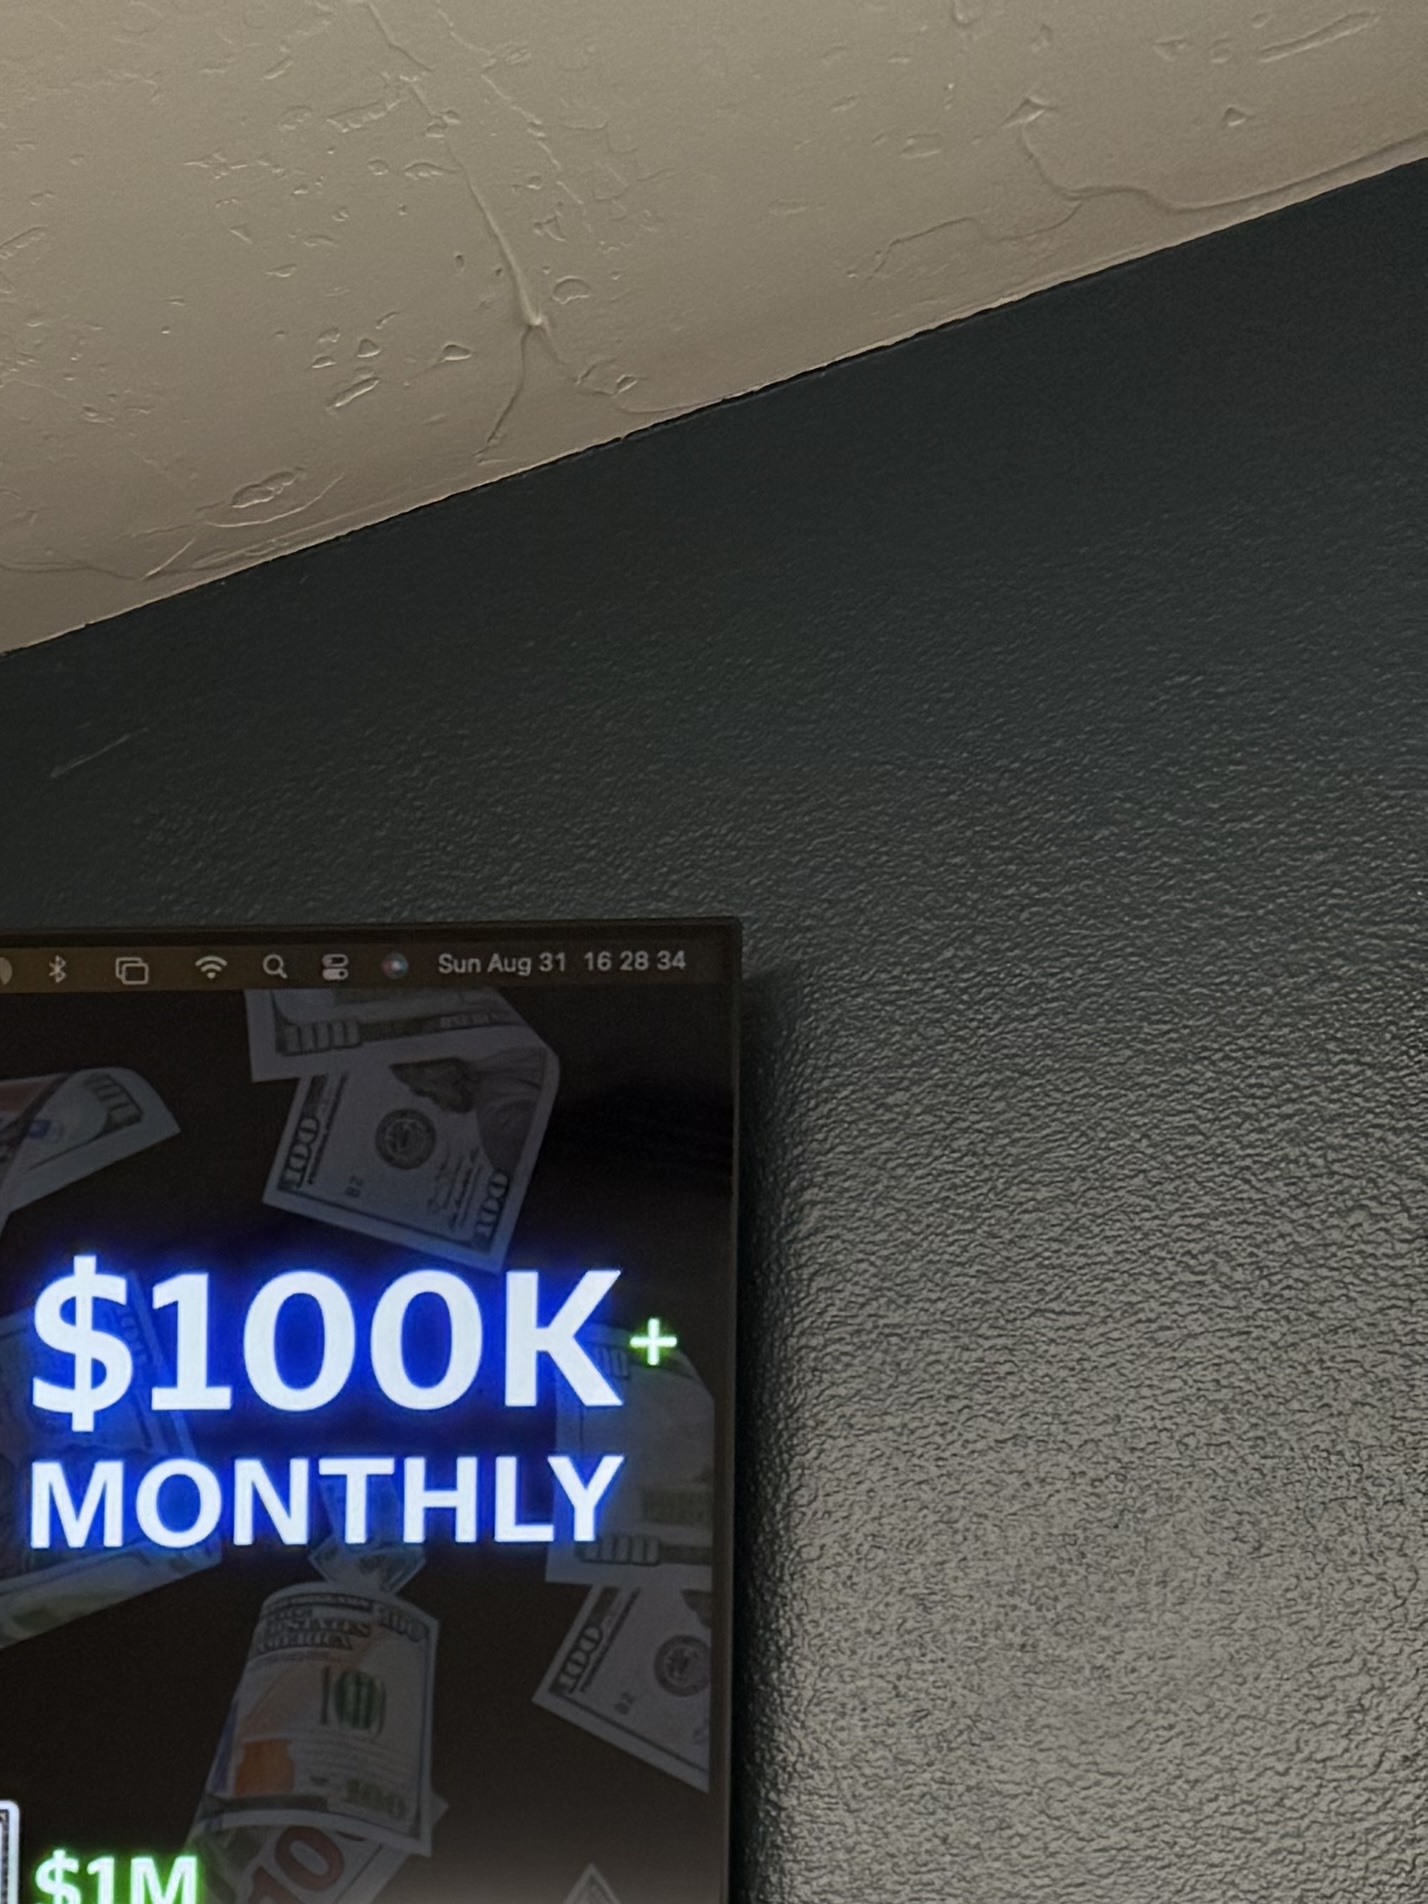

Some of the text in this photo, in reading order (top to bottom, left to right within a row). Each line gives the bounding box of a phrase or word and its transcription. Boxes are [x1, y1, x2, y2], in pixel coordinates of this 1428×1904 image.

[438, 953, 481, 973] Sun
[487, 953, 532, 976] Aug
[538, 952, 566, 972] 31
[30, 1455, 624, 1549] MONTHLY
